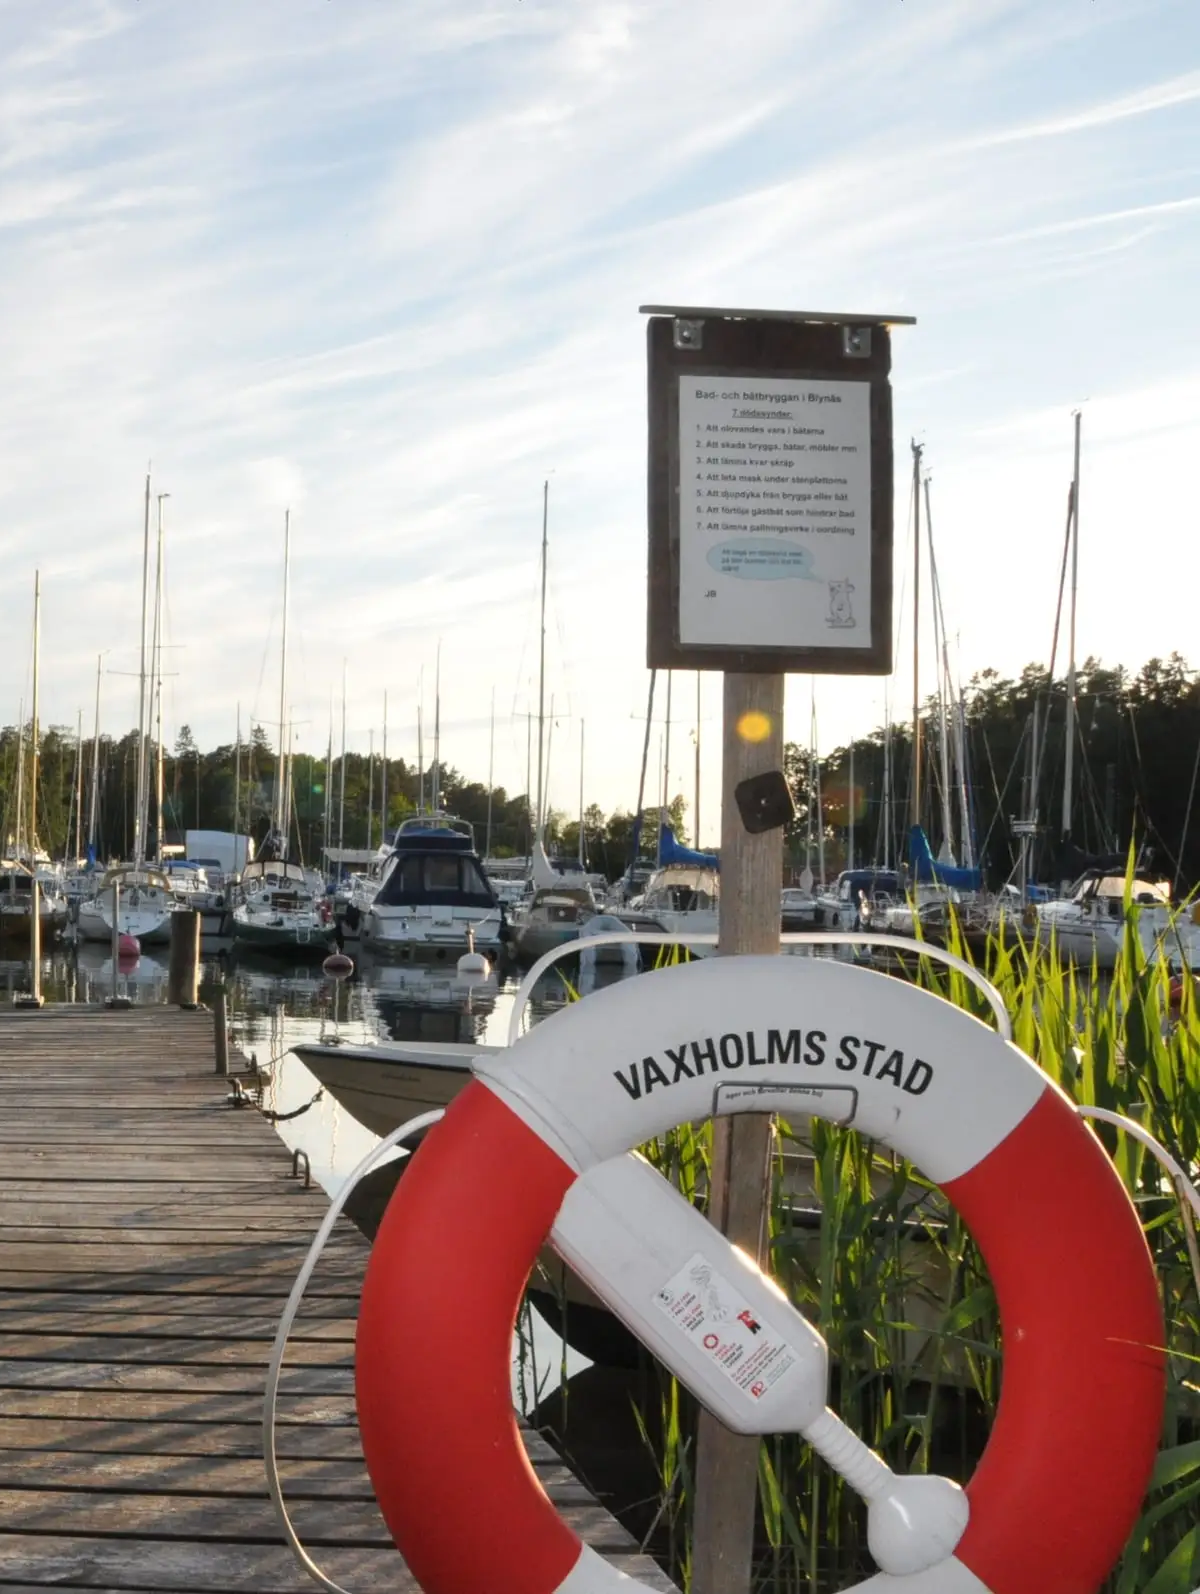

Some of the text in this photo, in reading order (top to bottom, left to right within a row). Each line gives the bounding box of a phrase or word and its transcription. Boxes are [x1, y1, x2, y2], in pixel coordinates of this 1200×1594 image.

[696, 390, 719, 399] Bad-
[722, 392, 739, 400] och
[743, 392, 799, 403] båtbryggan
[706, 424, 718, 432] Att
[764, 475, 789, 483] under
[763, 491, 779, 499] från
[782, 492, 811, 501] brygga
[707, 506, 718, 514] Att
[839, 510, 854, 518] bad
[705, 590, 716, 598] JB
[613, 1029, 934, 1101] VAXHOLMS STAD
